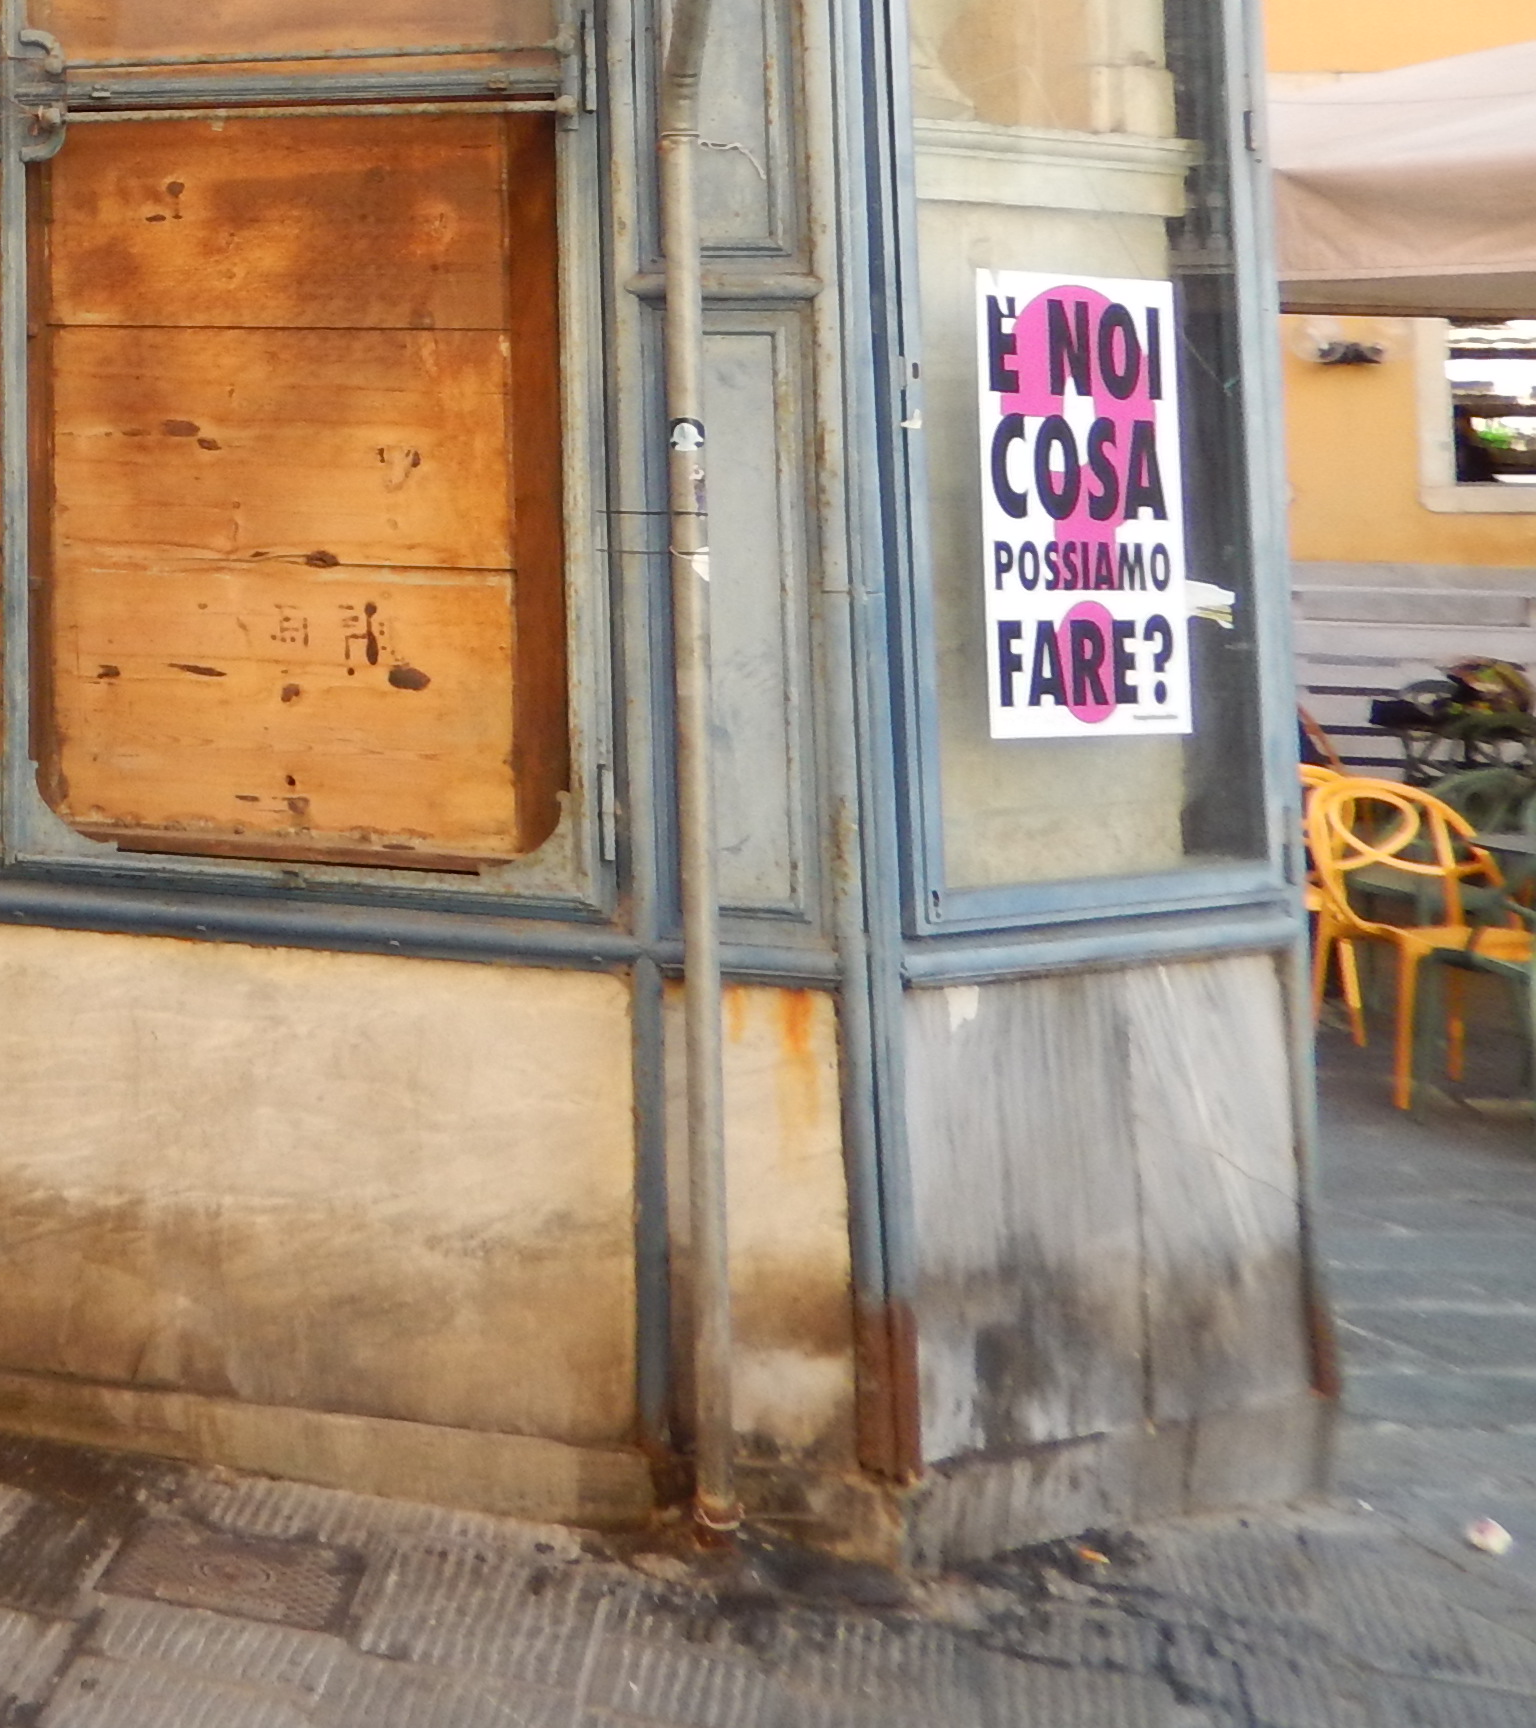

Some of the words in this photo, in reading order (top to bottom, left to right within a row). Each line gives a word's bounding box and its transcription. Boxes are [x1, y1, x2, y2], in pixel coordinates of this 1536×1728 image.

[1046, 298, 1163, 401] NOI
[991, 412, 1169, 522] COSA
[994, 540, 1171, 591] POSSIAMO
[997, 613, 1174, 707] FARE?
